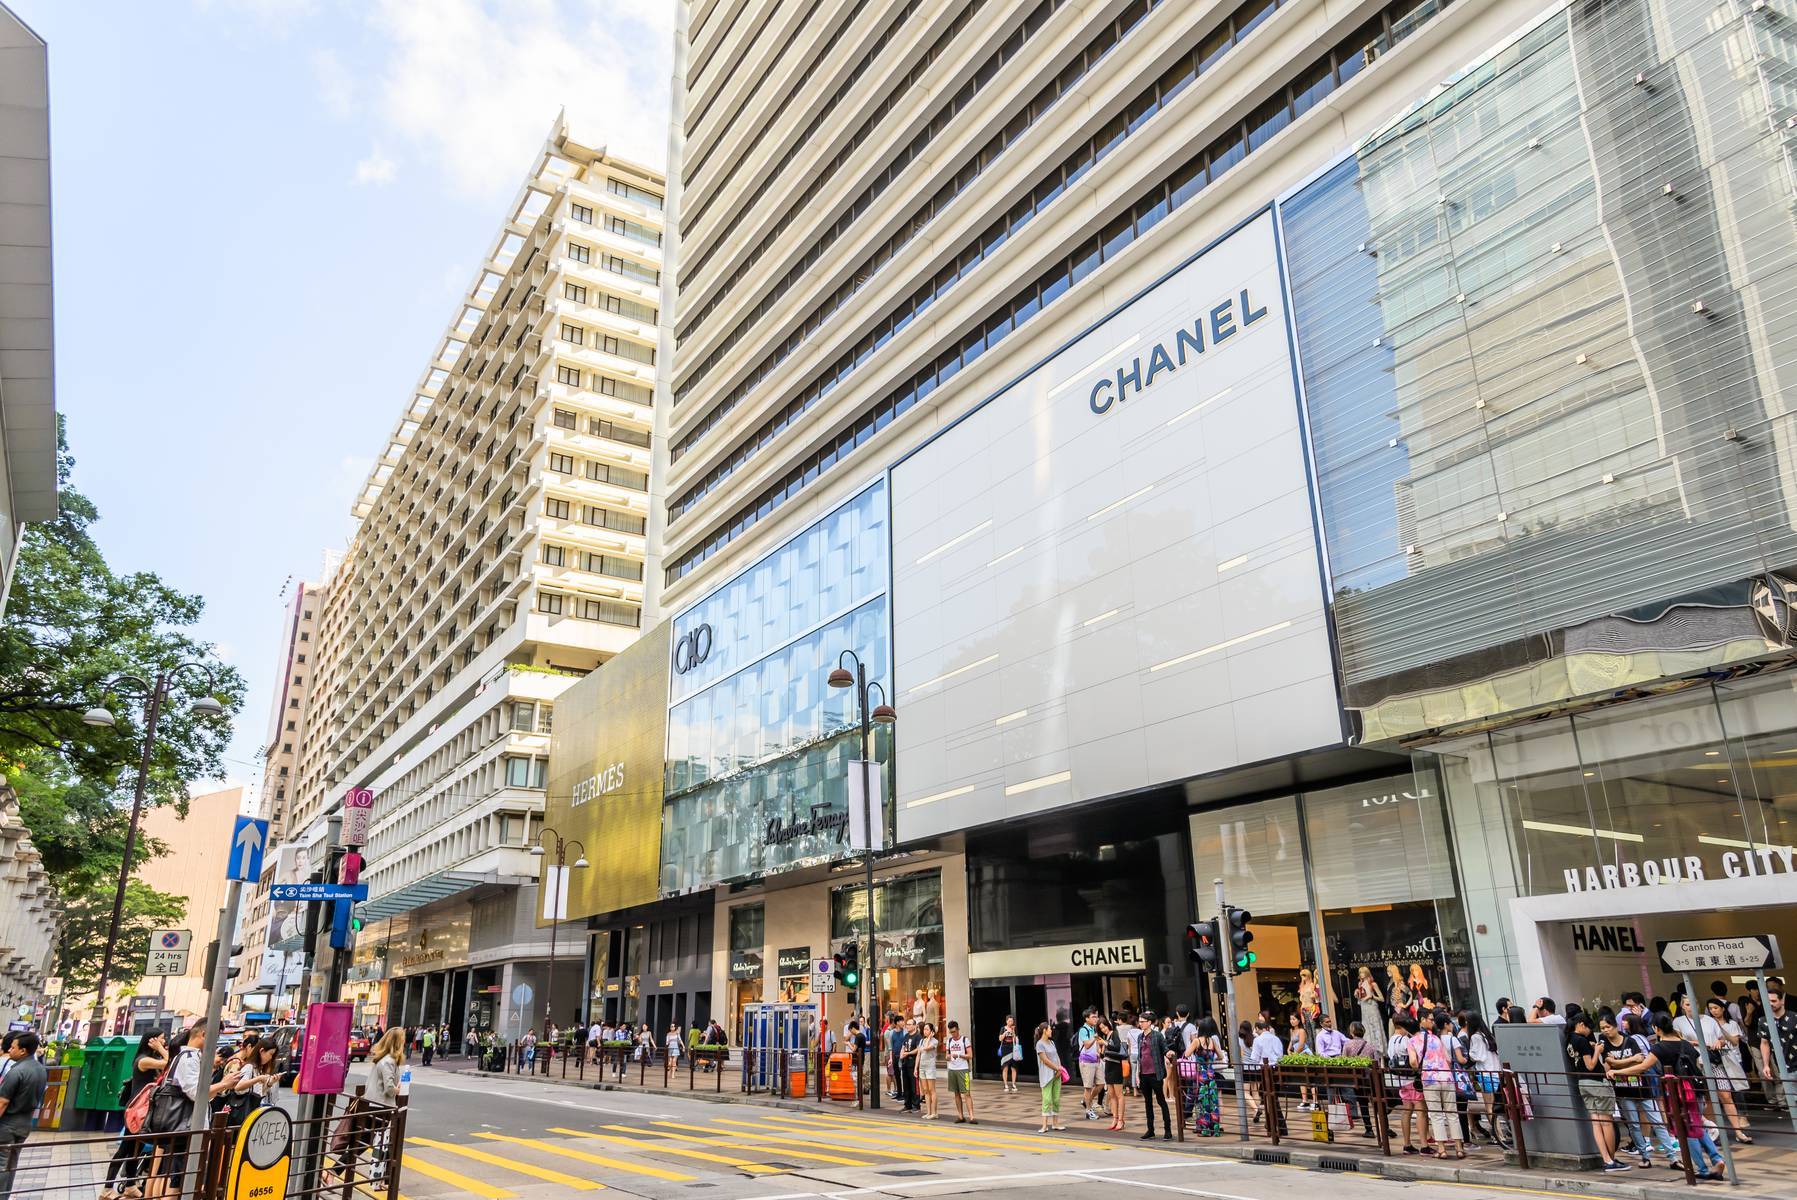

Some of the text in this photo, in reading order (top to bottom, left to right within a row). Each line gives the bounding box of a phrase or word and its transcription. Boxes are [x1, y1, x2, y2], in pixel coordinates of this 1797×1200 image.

[1089, 288, 1267, 415] CHANEL
[571, 761, 625, 808] HERMÈS
[1563, 846, 1793, 893] HARBOUR CITY
[1681, 941, 1744, 952] Canton Road
[154, 952, 182, 961] 24 hrs
[1071, 945, 1143, 967] CHANEL
[1695, 954, 1737, 967] 廣東道
[154, 961, 179, 974] 全日
